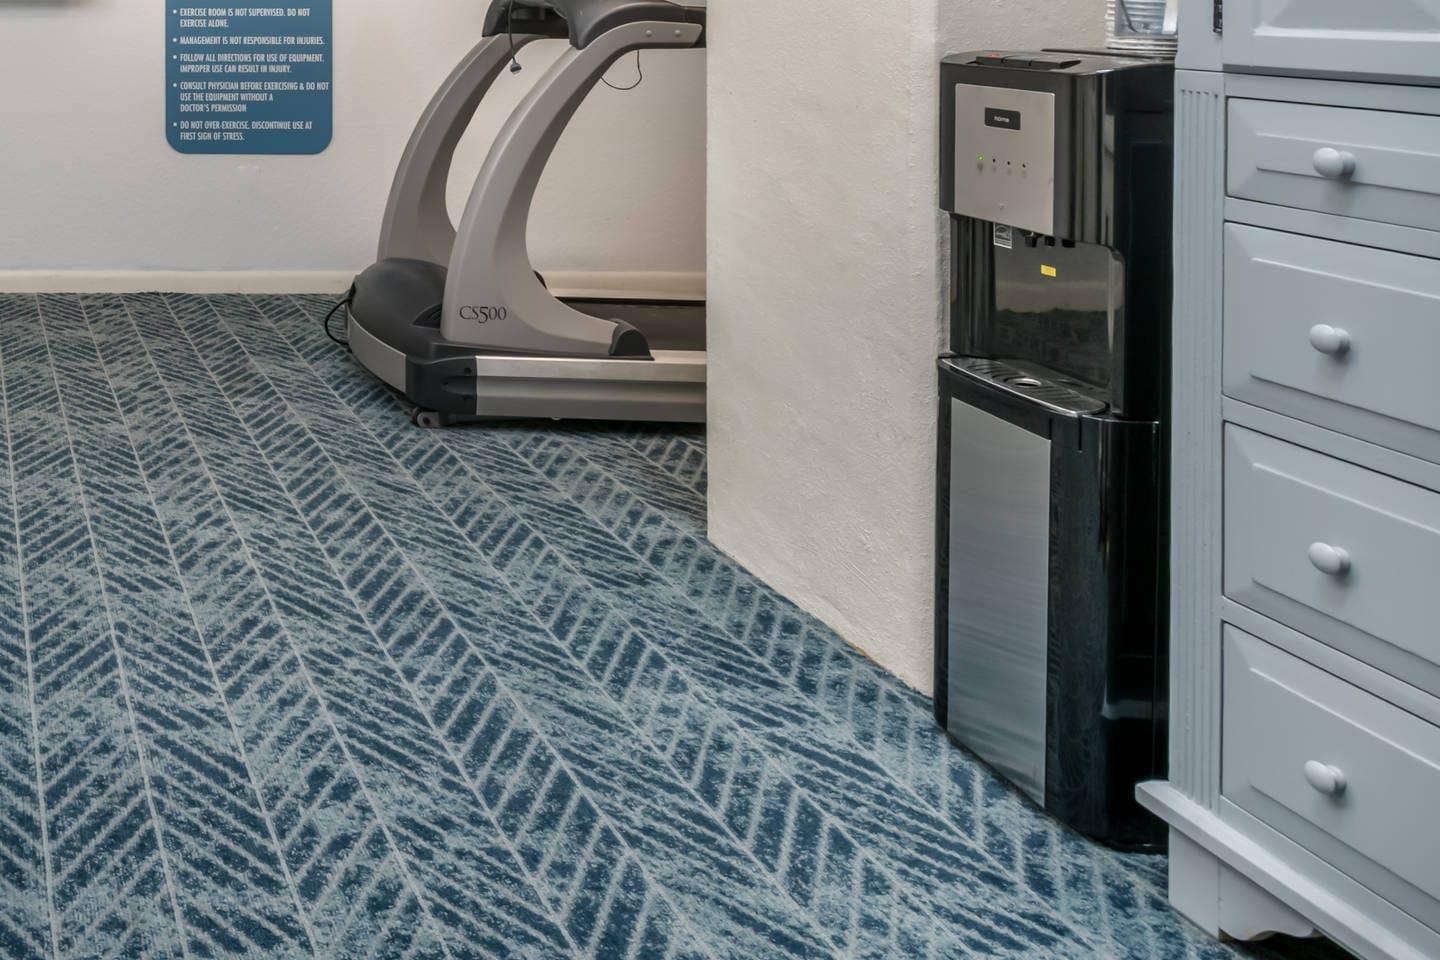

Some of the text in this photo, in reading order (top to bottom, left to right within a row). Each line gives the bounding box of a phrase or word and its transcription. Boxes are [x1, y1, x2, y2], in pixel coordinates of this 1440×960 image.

[180, 8, 310, 16] EXERCISE ROOM IS NOT SUPERVISED. DO NOT
[180, 19, 228, 28] EXERCISE ALONE.
[180, 37, 324, 45] MANAGEMENT IS NOT RESPONSIBLE FOR INJURIES.
[180, 54, 324, 62] FOLLOW ALL DIRECTIONS FOR USE OF EQUIPMENT.
[180, 82, 328, 90] CONSULT PHYSICIAN BEFORE EXERCISING & DO NOT
[180, 93, 273, 101] USE THE EQUIPMENT WITHOUT A
[180, 104, 246, 112] DOCTOR'S PERMISSION
[180, 121, 312, 129] DO NOT OVER-EXERCISE. DISCONTINUE USE AT
[180, 132, 245, 140] FIRST SIGN OF STRESS.
[459, 305, 507, 324] CS500
